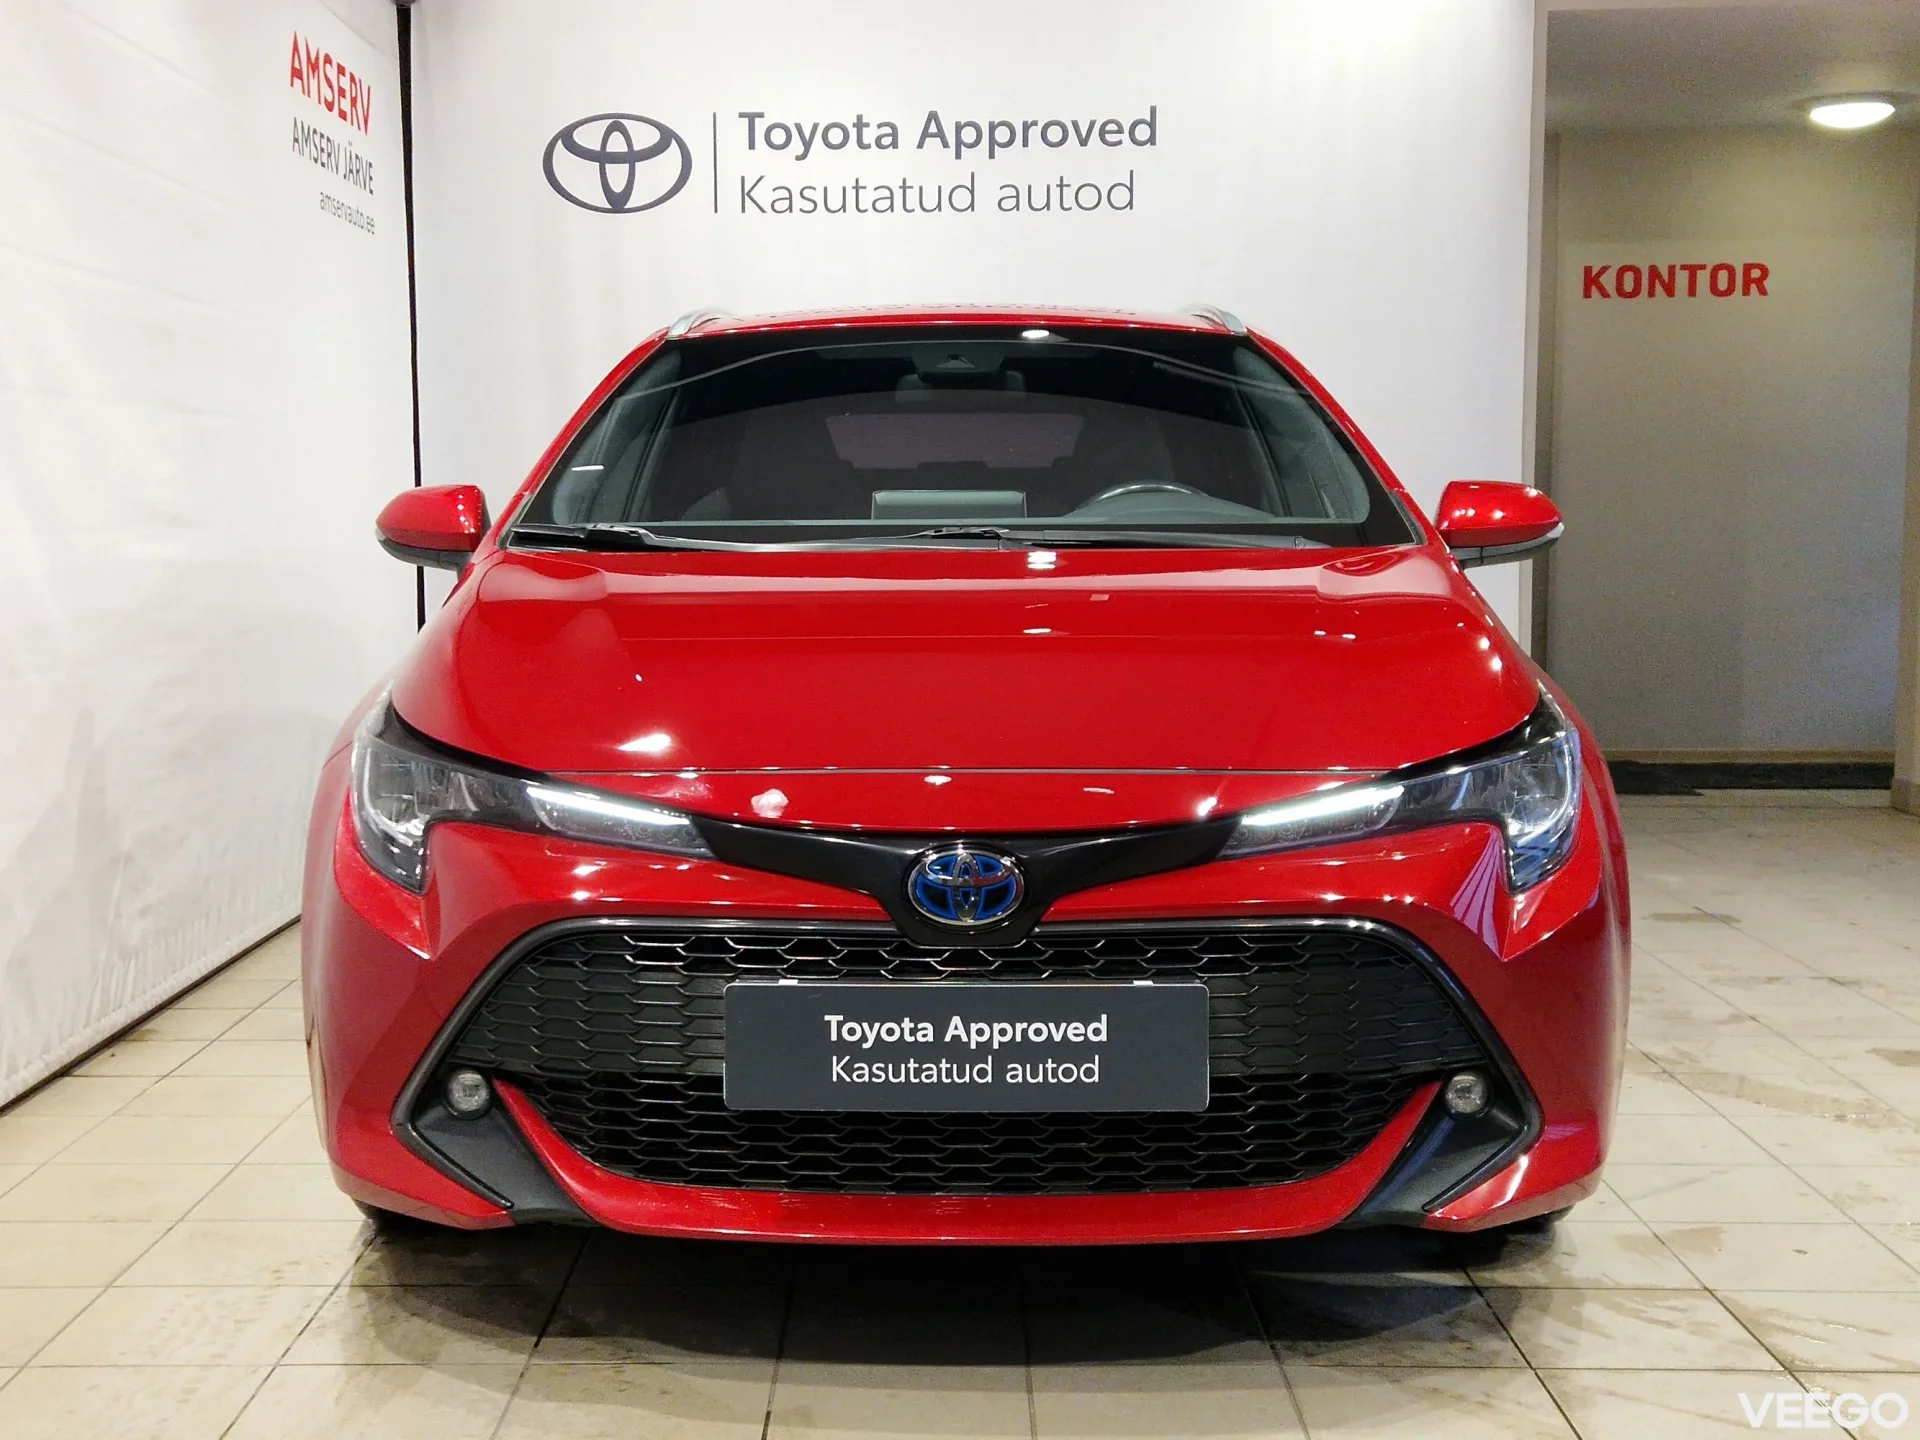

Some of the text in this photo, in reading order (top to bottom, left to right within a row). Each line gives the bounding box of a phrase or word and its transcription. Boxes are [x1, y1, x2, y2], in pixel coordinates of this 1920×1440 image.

[290, 31, 371, 135] AMSERV
[738, 105, 1158, 161] Toyota Approved
[292, 117, 374, 195] AMSERV JÄRVE
[320, 192, 375, 235] amservauto.ee
[739, 169, 1136, 214] Kasutatud autod
[1582, 263, 1770, 299] KONTOR
[824, 1014, 1108, 1049] Toyota Approved
[832, 1055, 1100, 1084] Kasutatud autod
